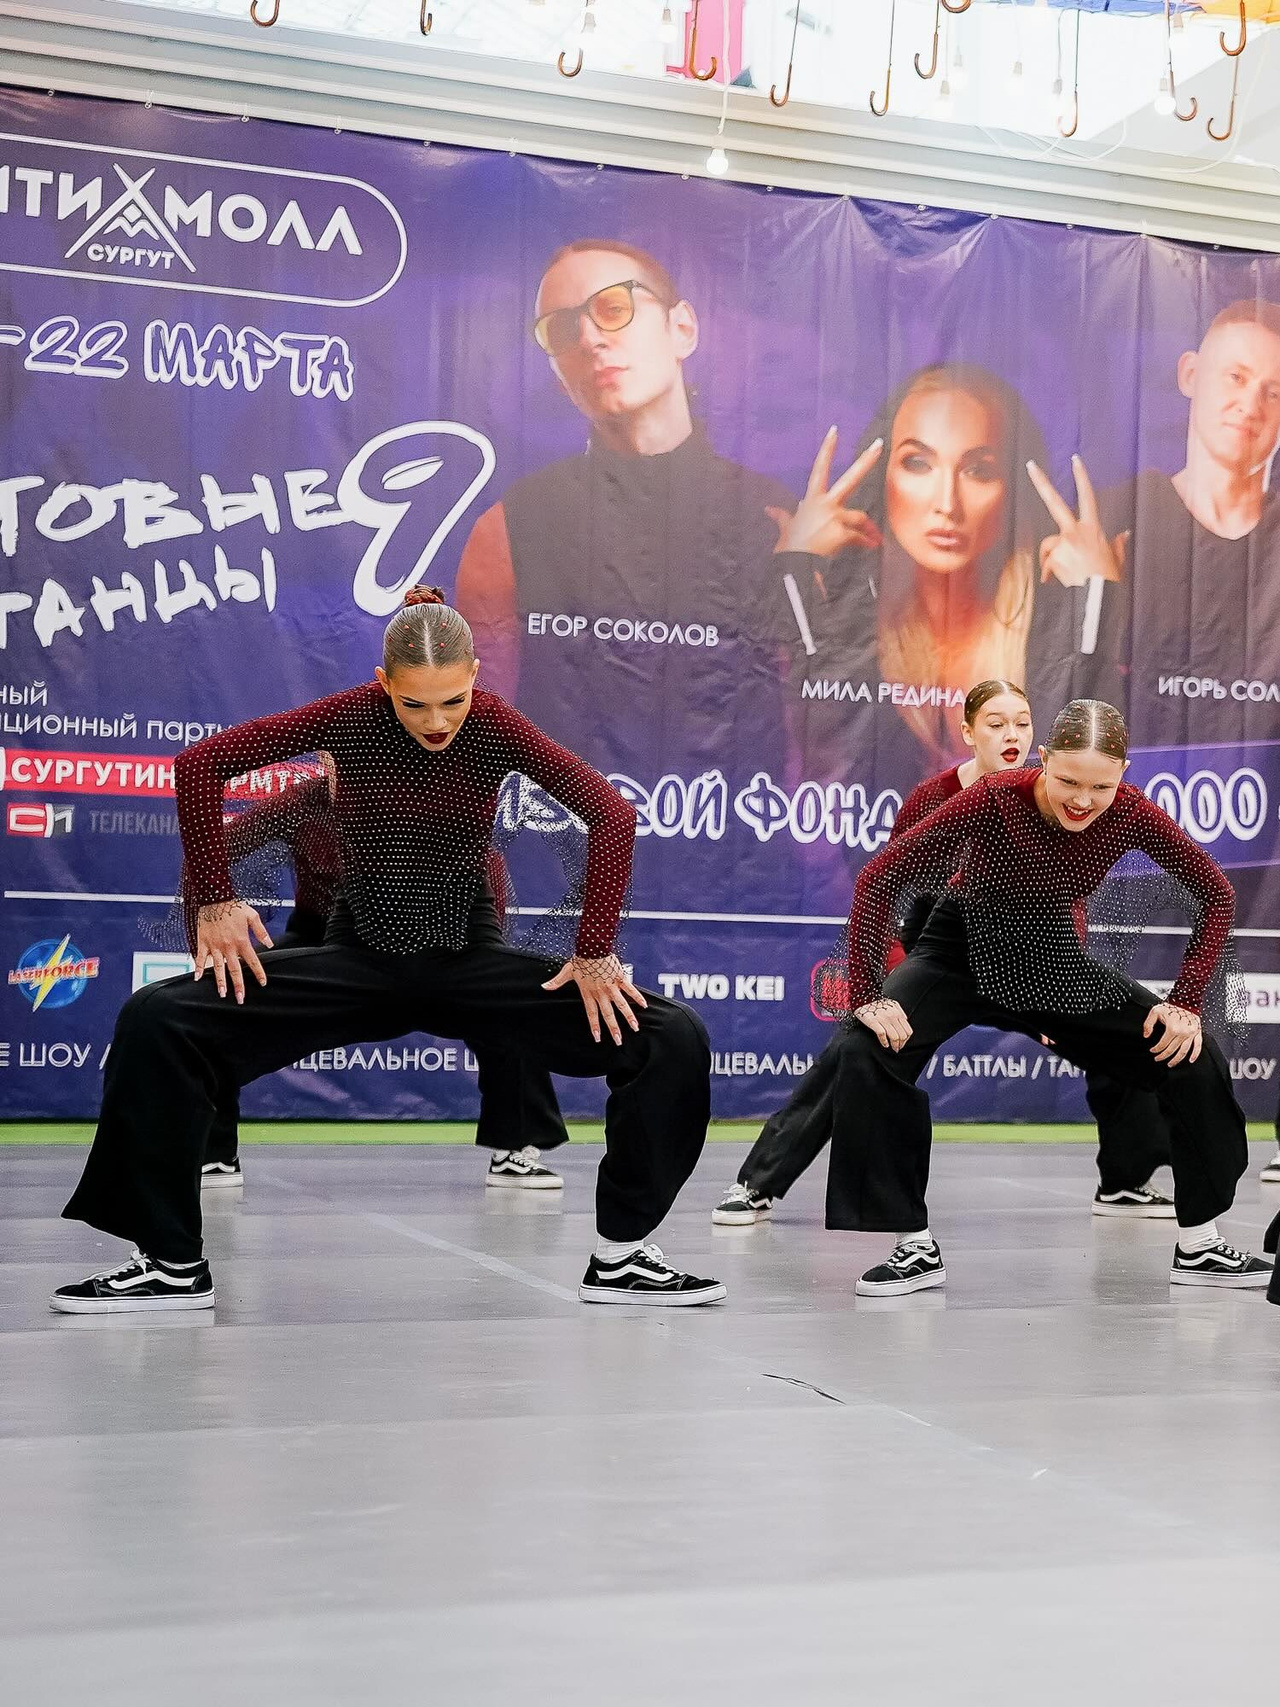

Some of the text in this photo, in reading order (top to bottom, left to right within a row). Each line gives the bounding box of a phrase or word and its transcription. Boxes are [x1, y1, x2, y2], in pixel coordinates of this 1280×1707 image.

[0, 164, 363, 256] ТИ МОЛЛ
[87, 243, 175, 269] СУРГУТ
[143, 319, 354, 401] МАРТА
[528, 612, 720, 647] ЕГОР СОКОЛОВ
[801, 679, 966, 708] МИЛА РЕДИНА
[1158, 675, 1228, 700] ИГОРЬ
[0, 712, 232, 747] ционный парт
[89, 810, 181, 835] ТЕЛЕКАНА
[657, 973, 730, 1000] TWO
[735, 975, 785, 1001] KEI
[19, 1042, 92, 1068] ШОУ
[292, 1046, 457, 1072] ЦЕВАЛЬНОЕ
[943, 1054, 1027, 1078] БАТТЛЫ
